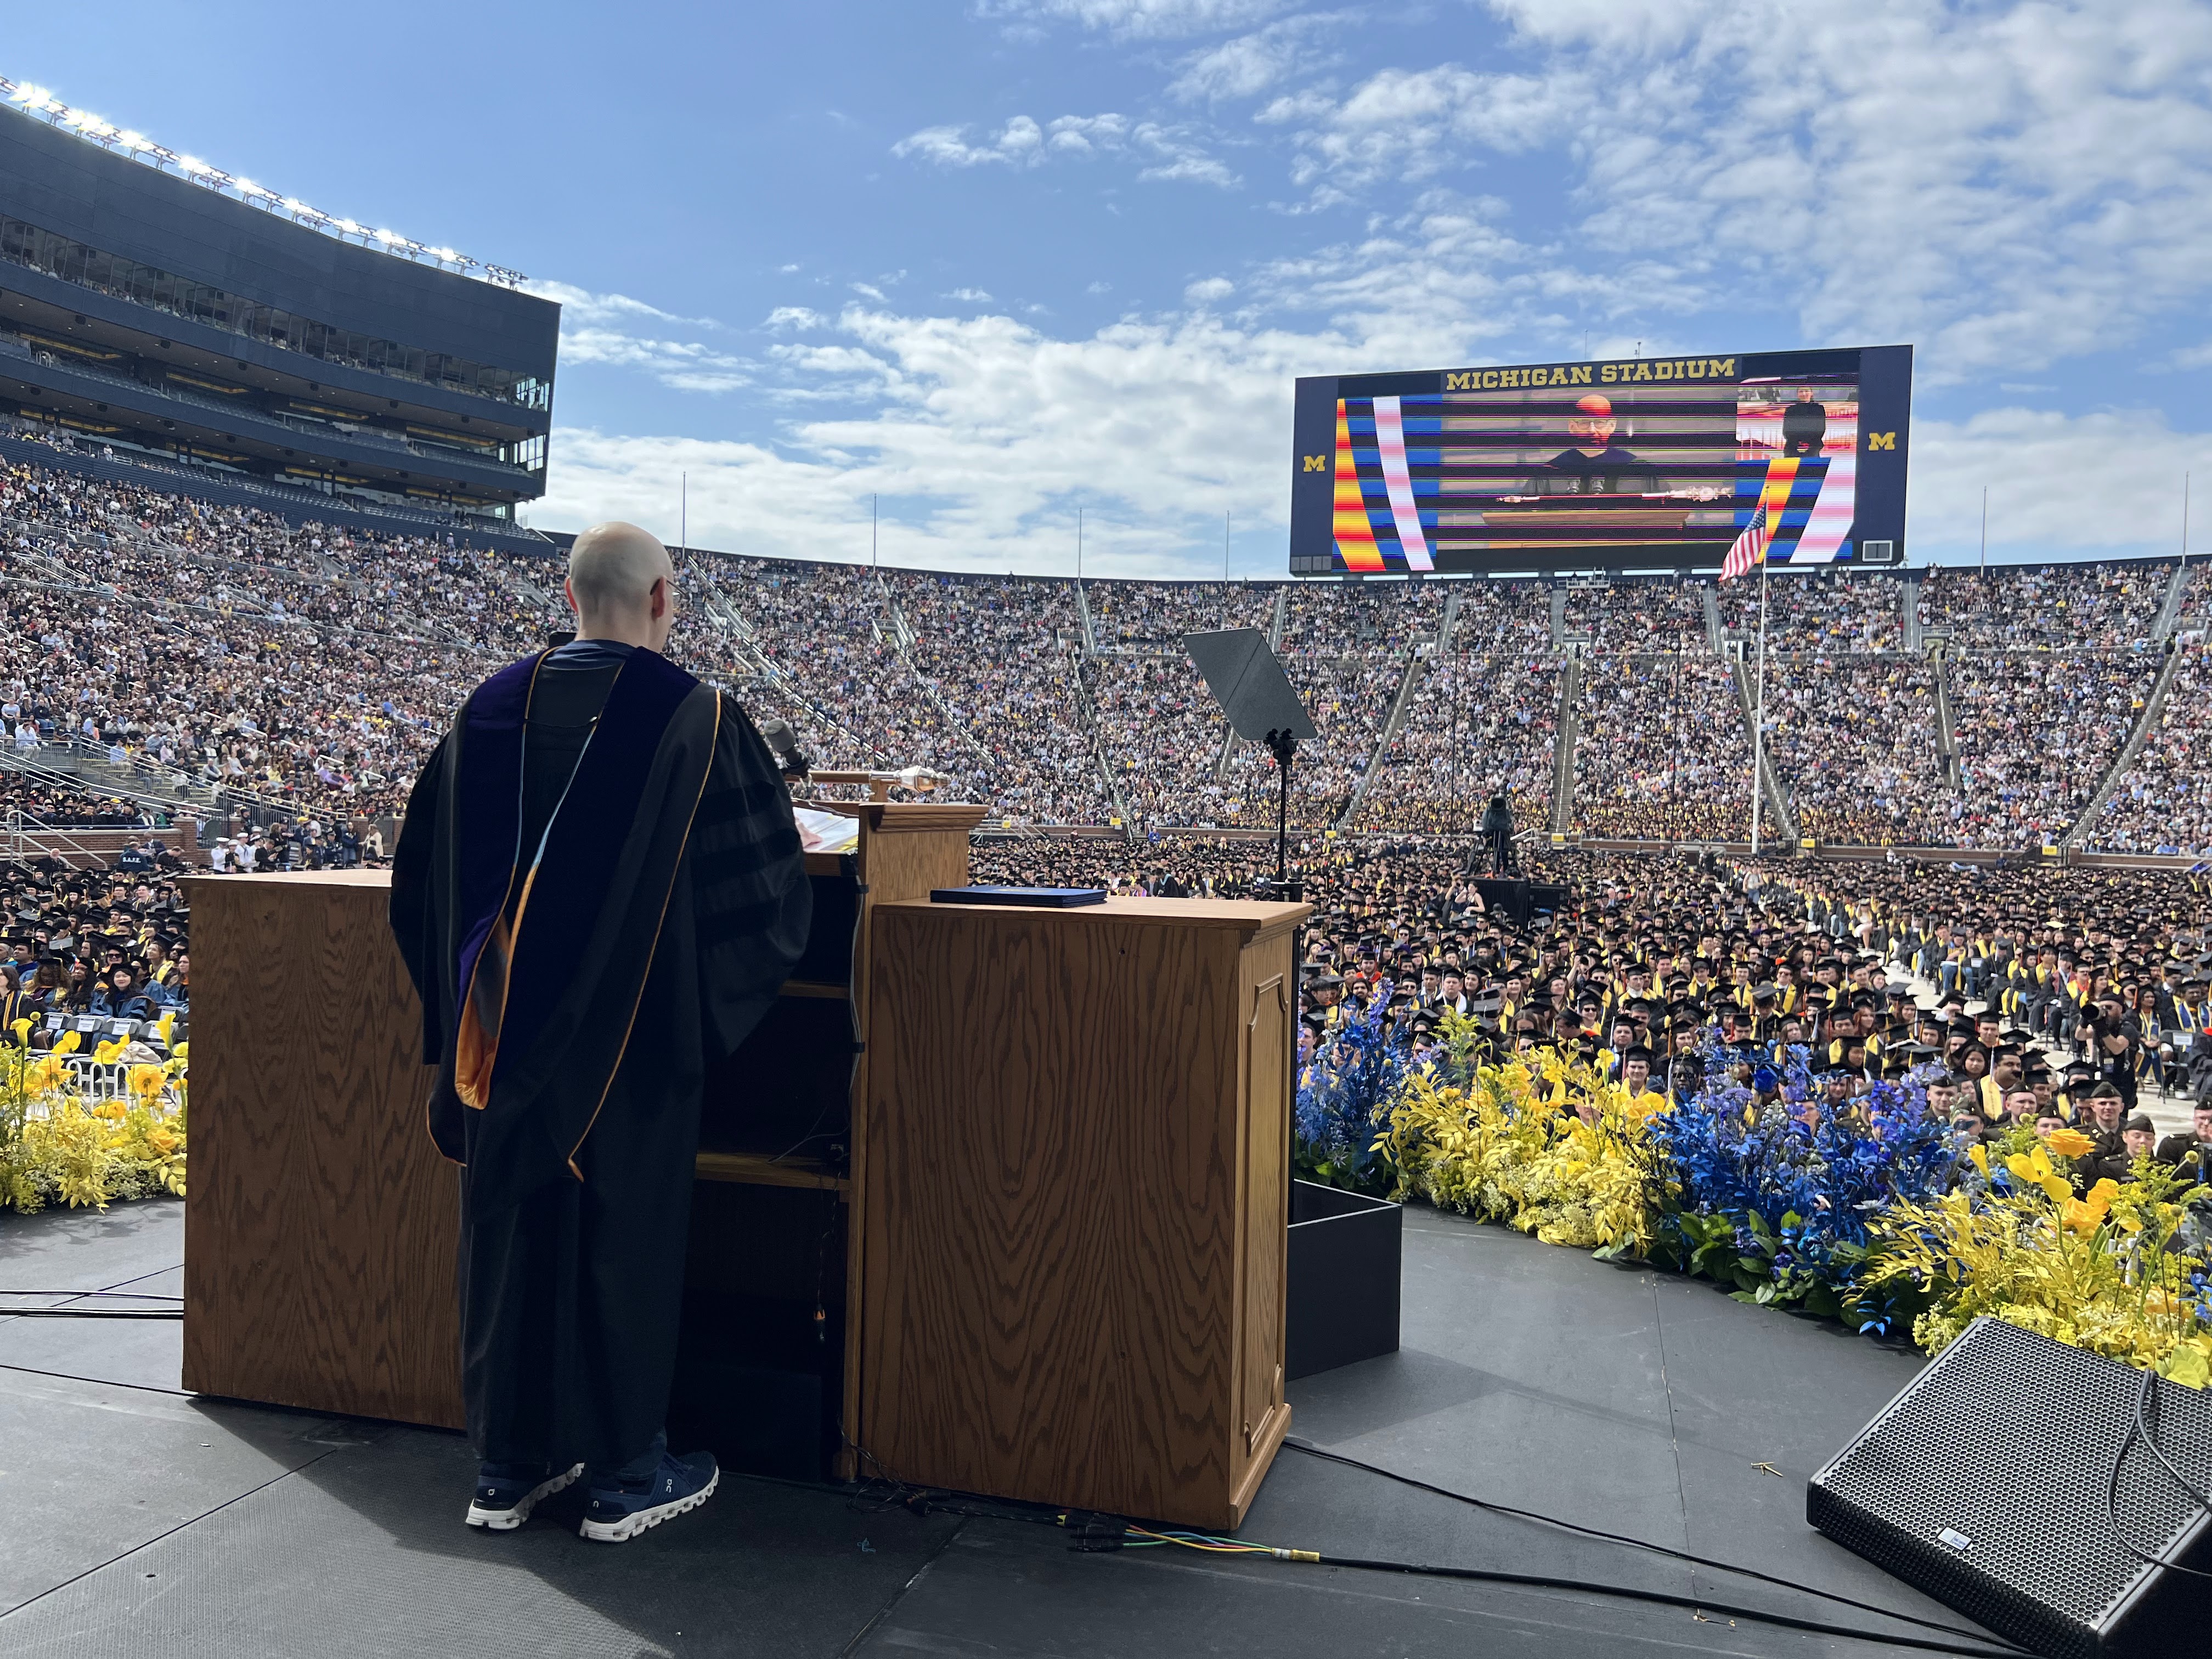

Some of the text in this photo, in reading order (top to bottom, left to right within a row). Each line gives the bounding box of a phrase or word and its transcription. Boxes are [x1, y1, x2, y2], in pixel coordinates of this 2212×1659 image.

[1446, 358, 1735, 391] MICHIGAN STADIUM
[1868, 432, 1895, 451] M
[1303, 455, 1325, 472] M
